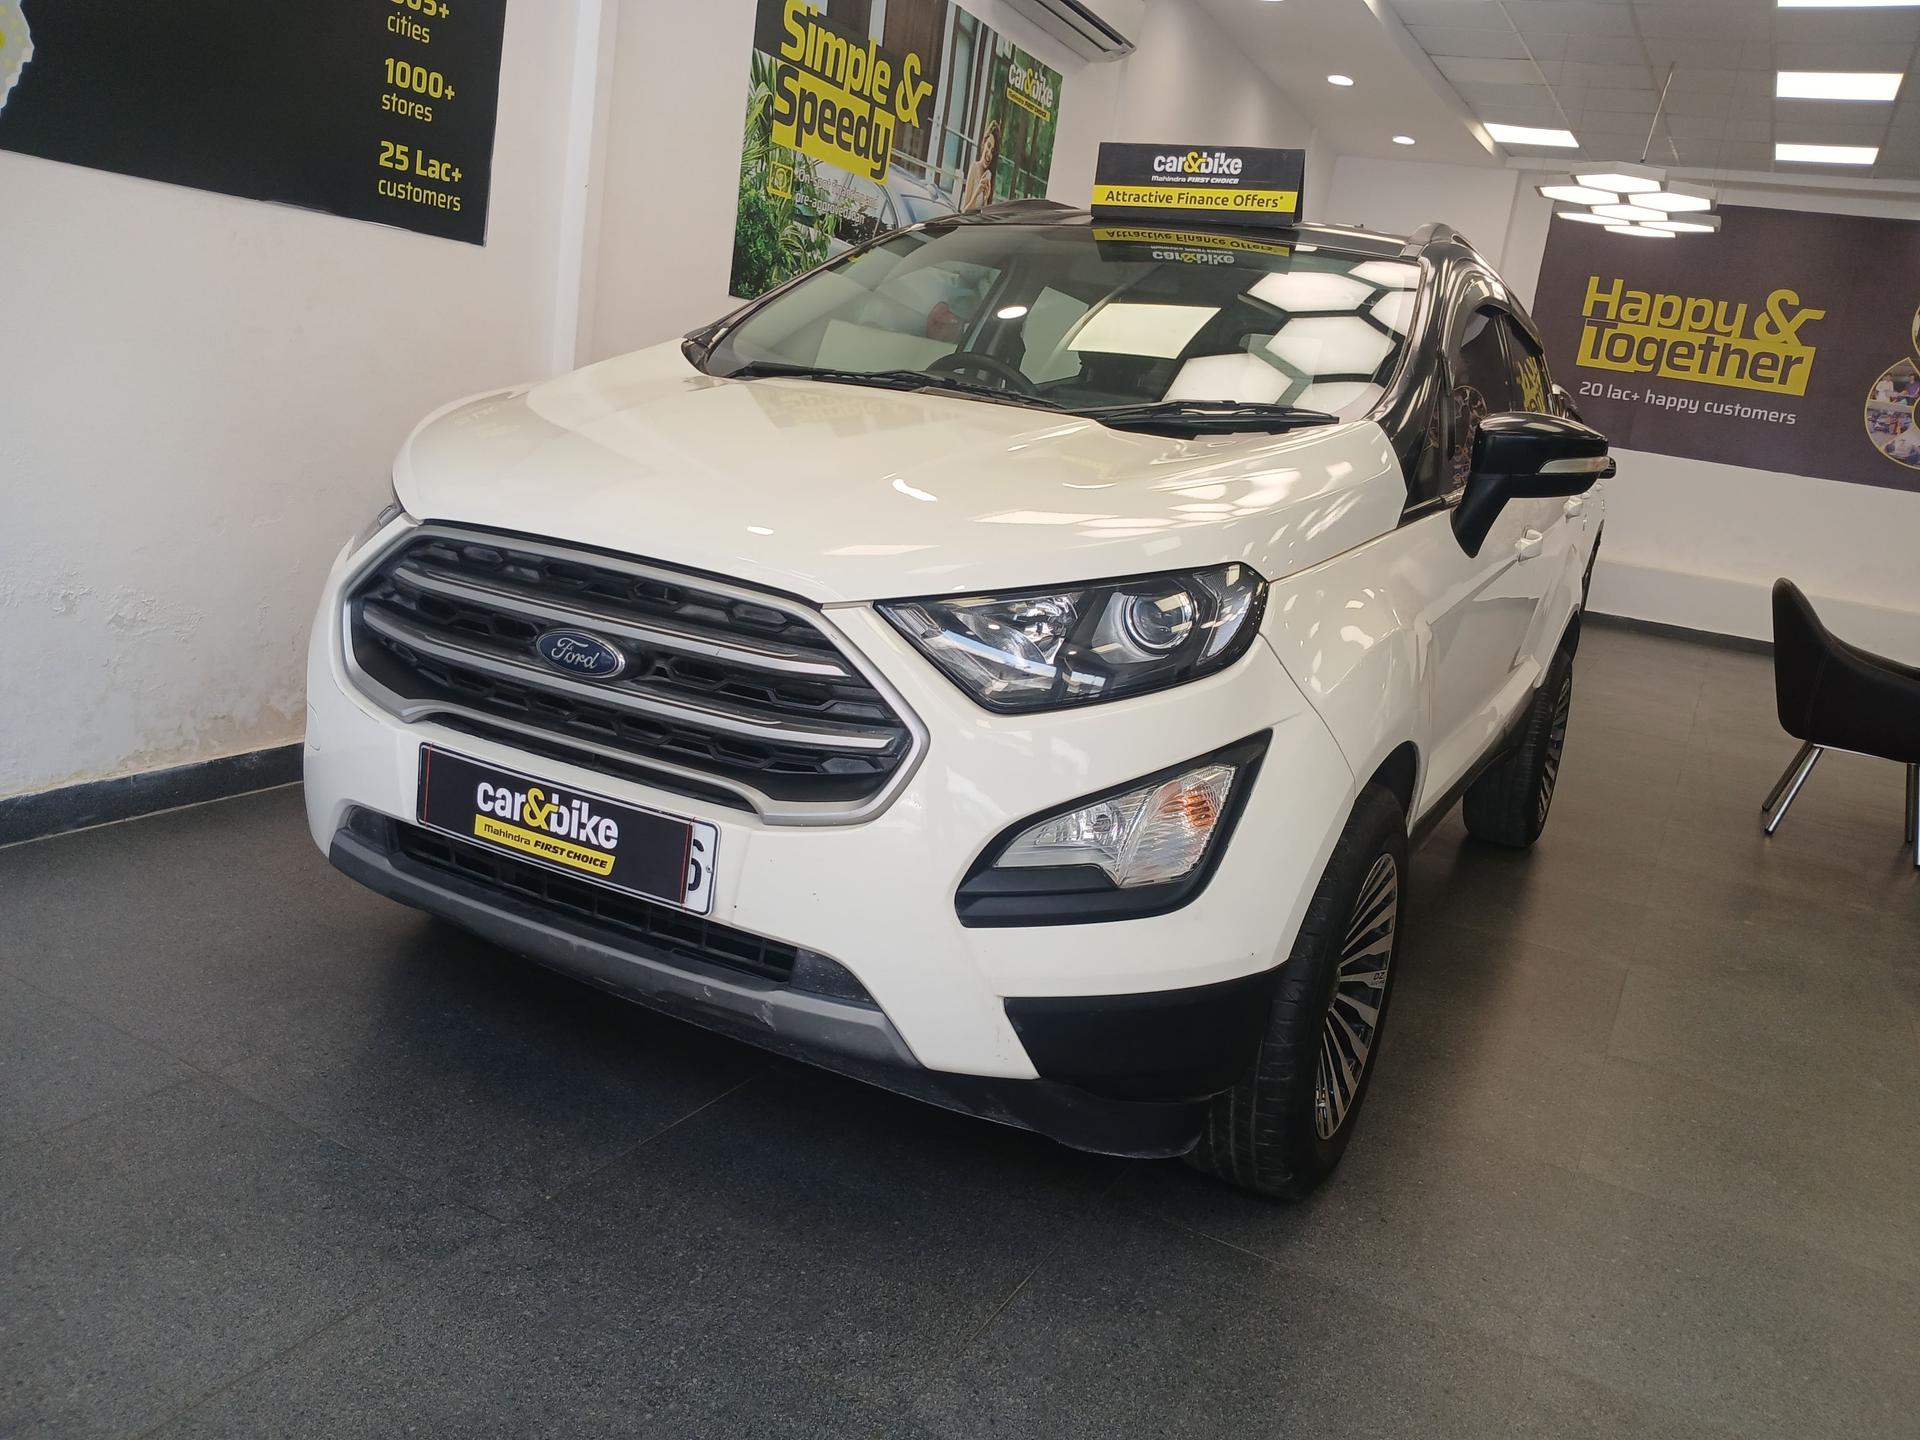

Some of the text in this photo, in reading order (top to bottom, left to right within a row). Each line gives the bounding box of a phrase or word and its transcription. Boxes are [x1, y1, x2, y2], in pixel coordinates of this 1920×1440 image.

[387, 12, 430, 43] cities
[390, 0, 449, 18] 5+
[385, 58, 455, 100] 1000+
[781, 0, 933, 128] Simple &
[1008, 64, 1053, 108] car&bike
[382, 93, 432, 122] stores
[774, 64, 890, 181] Speedy
[379, 140, 462, 182] 25 Lac+
[1151, 175, 1186, 183] Mahindra
[1211, 177, 1240, 185] CHOICE
[1153, 151, 1243, 175] car&bike
[378, 179, 461, 211] customers
[1105, 190, 1174, 204] Attractive
[1177, 192, 1229, 206] Finance
[1582, 276, 1826, 346] Happy &
[1586, 319, 1804, 386] Together
[1579, 381, 1797, 425] 20 lac+ happy customers
[551, 637, 600, 669] Ford
[476, 782, 619, 850] car&bike
[484, 823, 608, 869] Mahindra FIRST CHOICE
